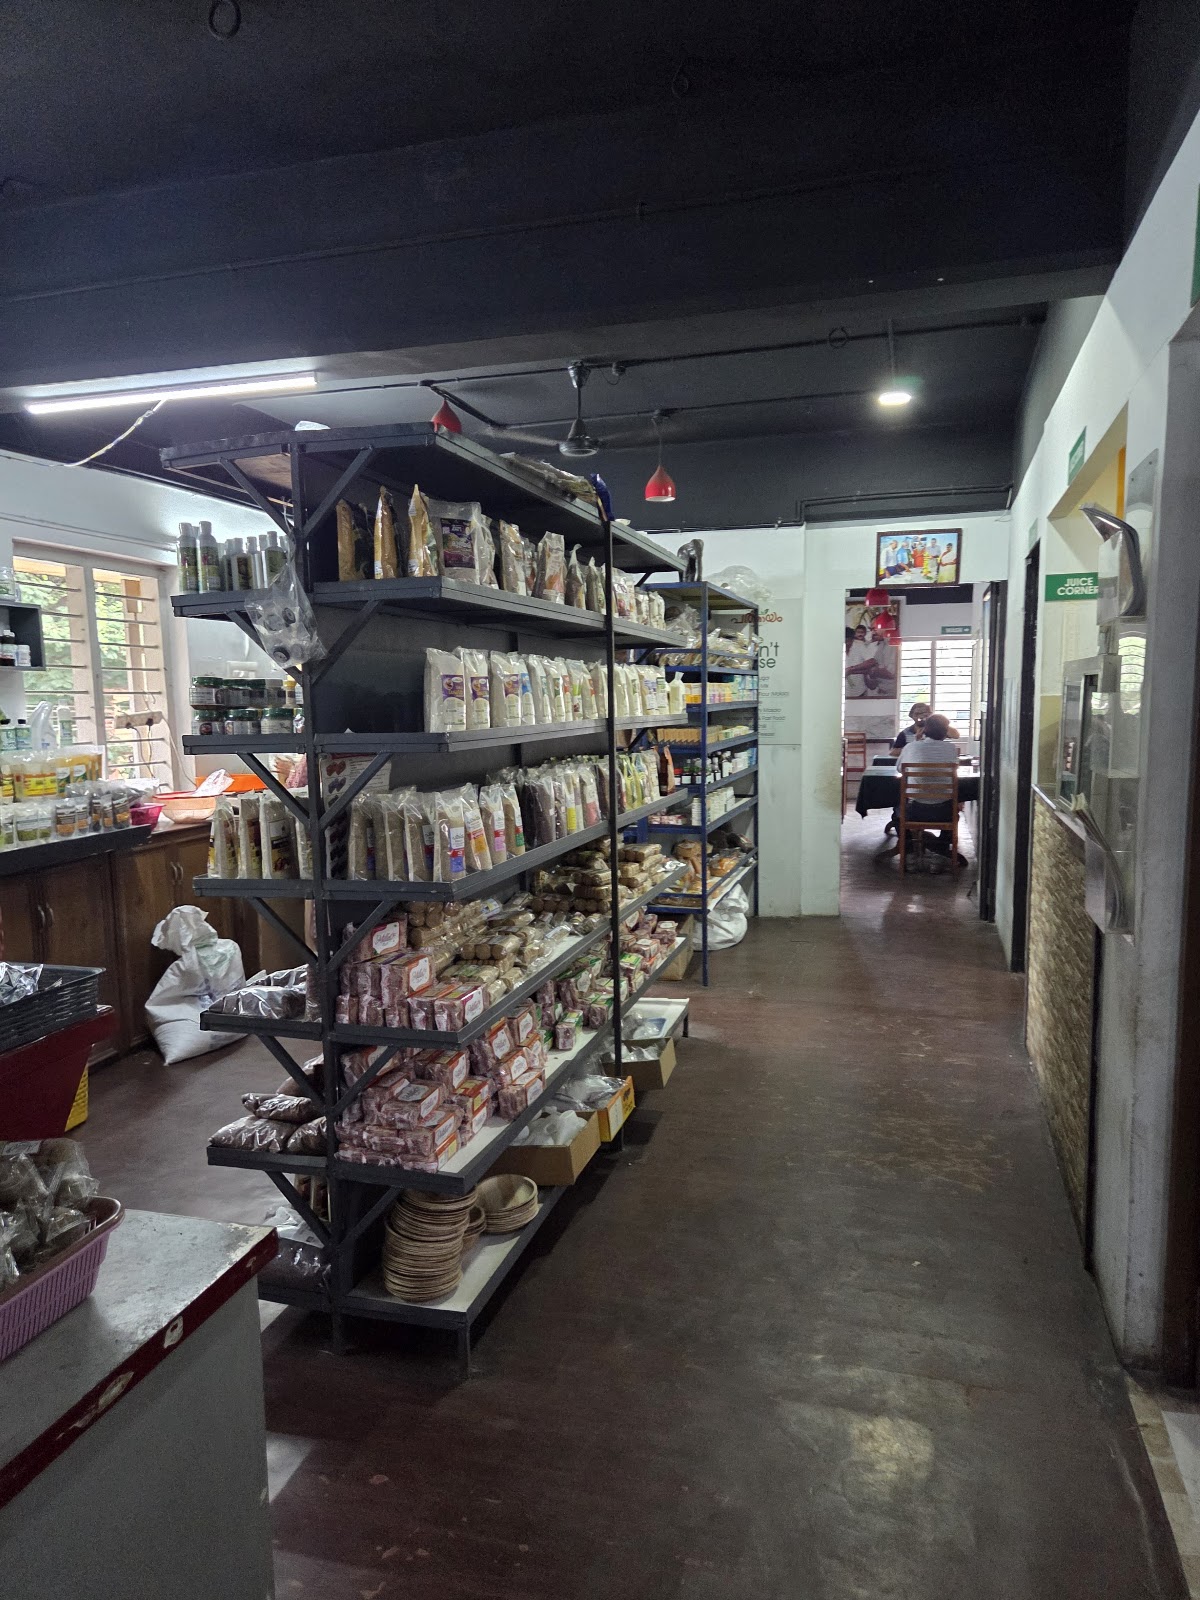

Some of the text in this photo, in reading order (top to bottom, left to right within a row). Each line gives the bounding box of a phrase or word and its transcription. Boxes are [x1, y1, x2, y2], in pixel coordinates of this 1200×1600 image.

[1064, 577, 1094, 587] JUICE
[759, 641, 779, 658] n't
[758, 658, 777, 669] se
